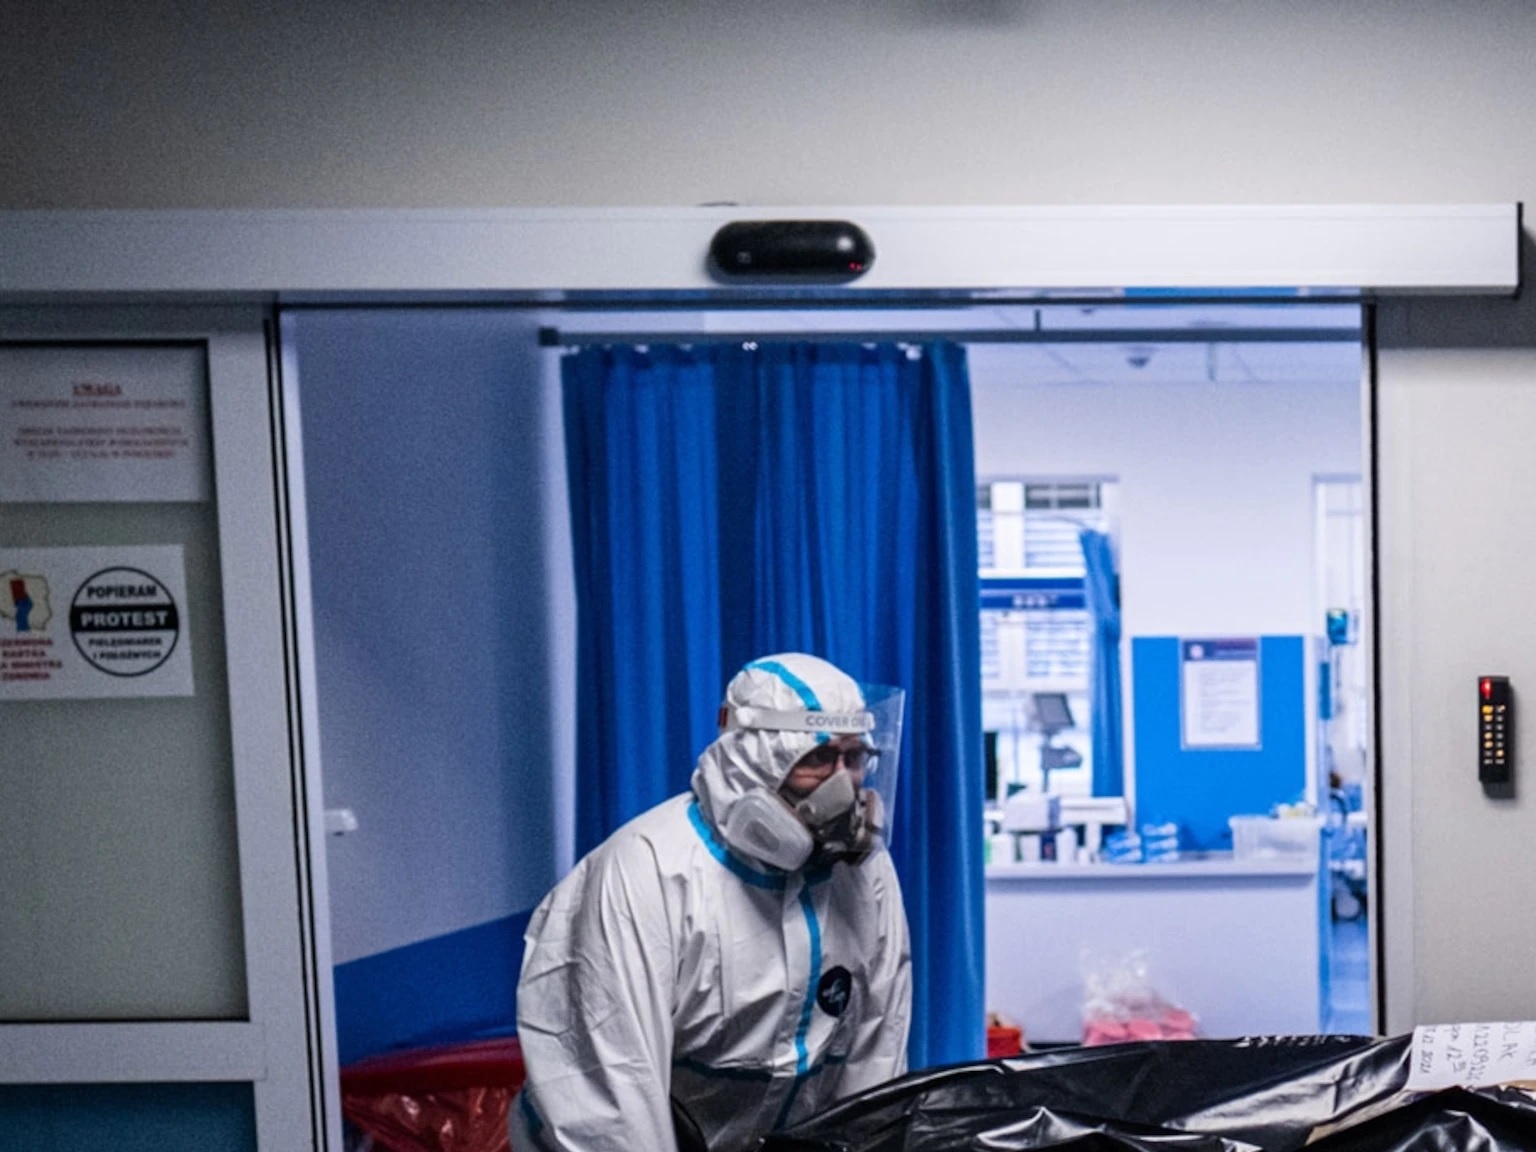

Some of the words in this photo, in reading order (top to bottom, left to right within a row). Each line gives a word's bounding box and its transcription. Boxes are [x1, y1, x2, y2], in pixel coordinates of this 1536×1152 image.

[87, 585, 158, 599] POPIERAM
[79, 610, 169, 627] PROTEST
[805, 715, 849, 728] COVER
